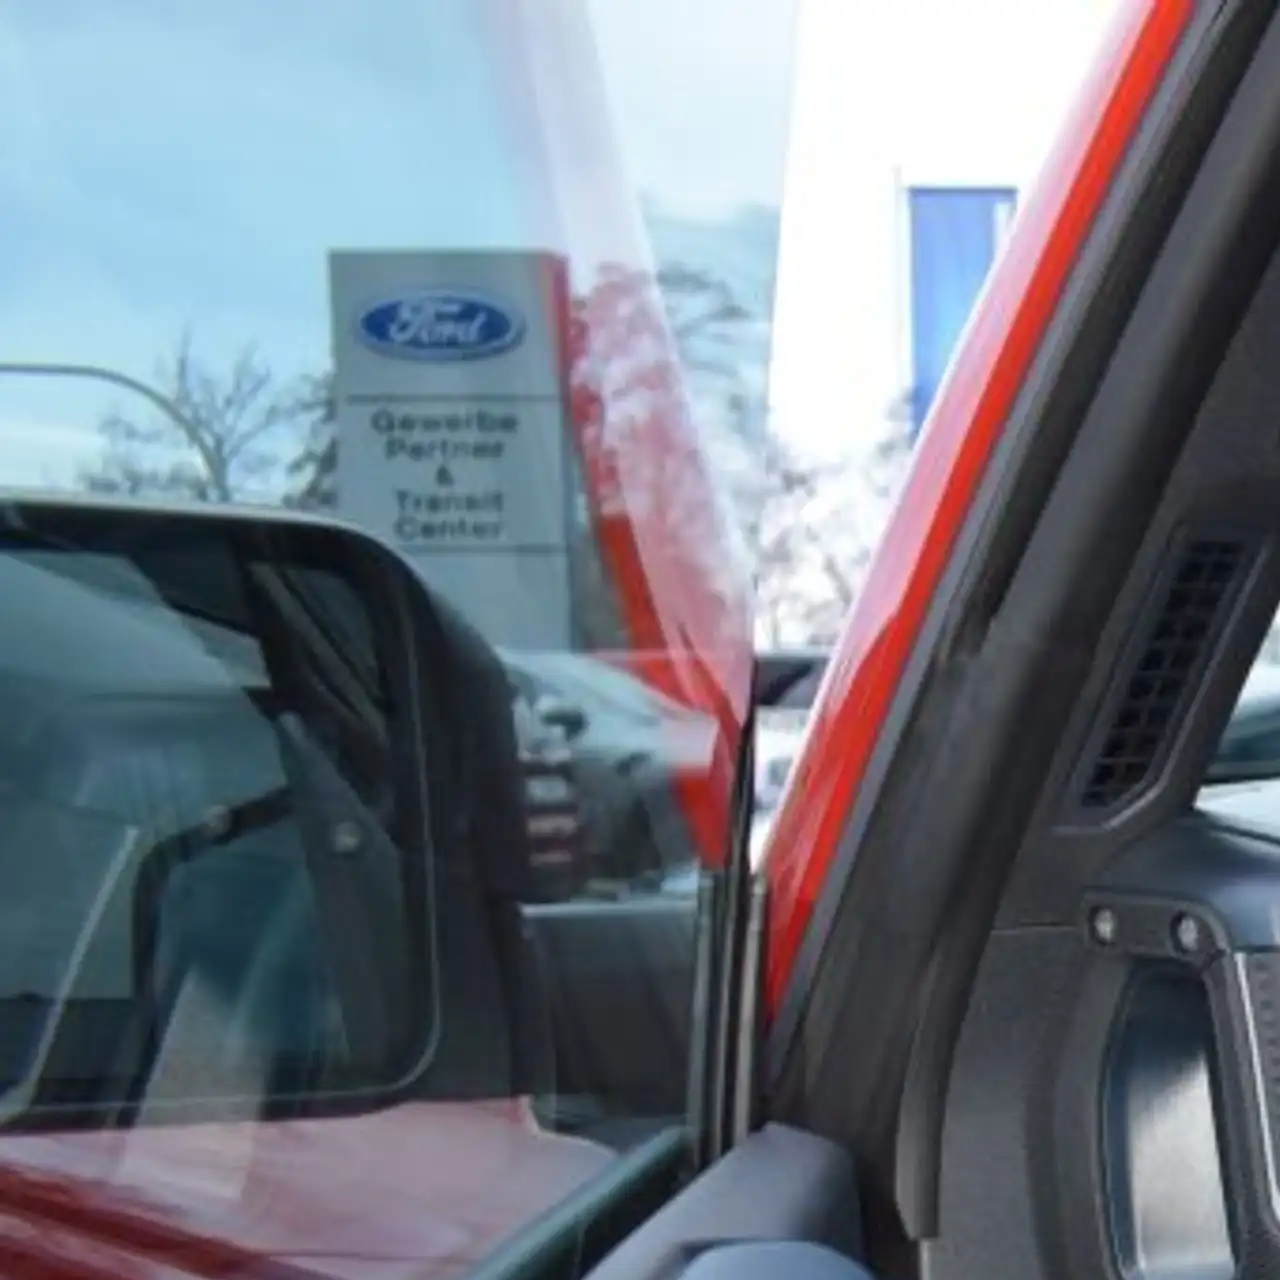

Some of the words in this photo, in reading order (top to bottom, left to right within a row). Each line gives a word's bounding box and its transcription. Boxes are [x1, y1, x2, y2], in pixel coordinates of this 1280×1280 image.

[388, 299, 489, 347] Ford
[371, 408, 519, 434] Gewerbe
[384, 436, 505, 461] Partner
[396, 488, 504, 513] Transit
[393, 516, 502, 541] Center
